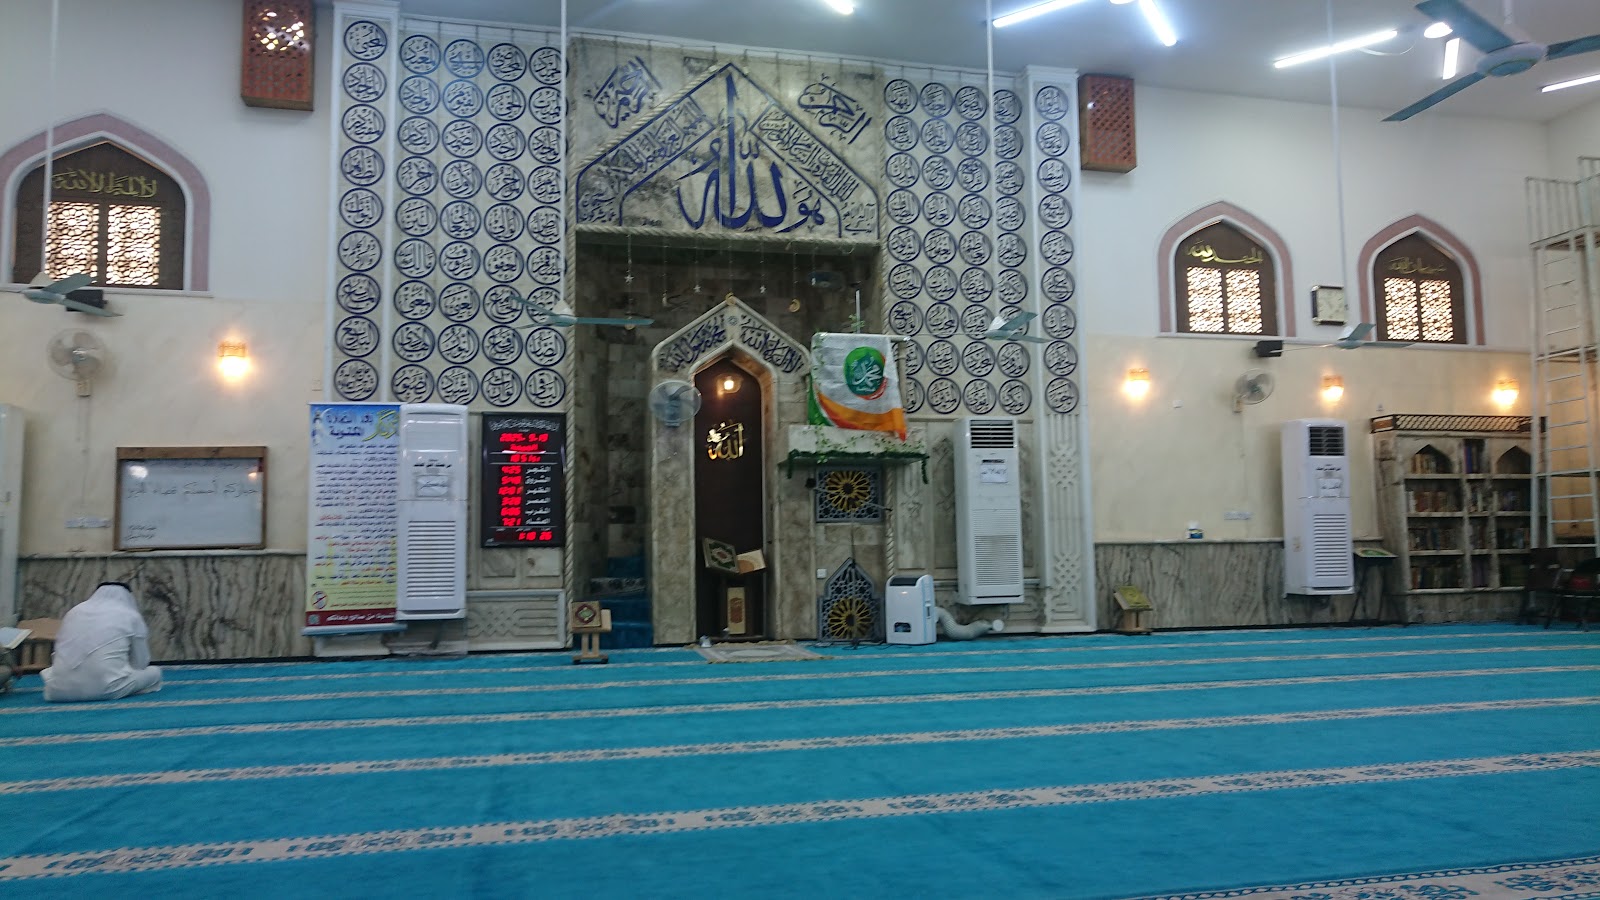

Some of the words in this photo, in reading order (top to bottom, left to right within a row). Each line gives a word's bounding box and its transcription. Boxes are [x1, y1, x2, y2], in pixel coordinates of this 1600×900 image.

[798, 73, 872, 145] الرحمن
[676, 72, 788, 231] الله
[706, 421, 744, 461] الله
